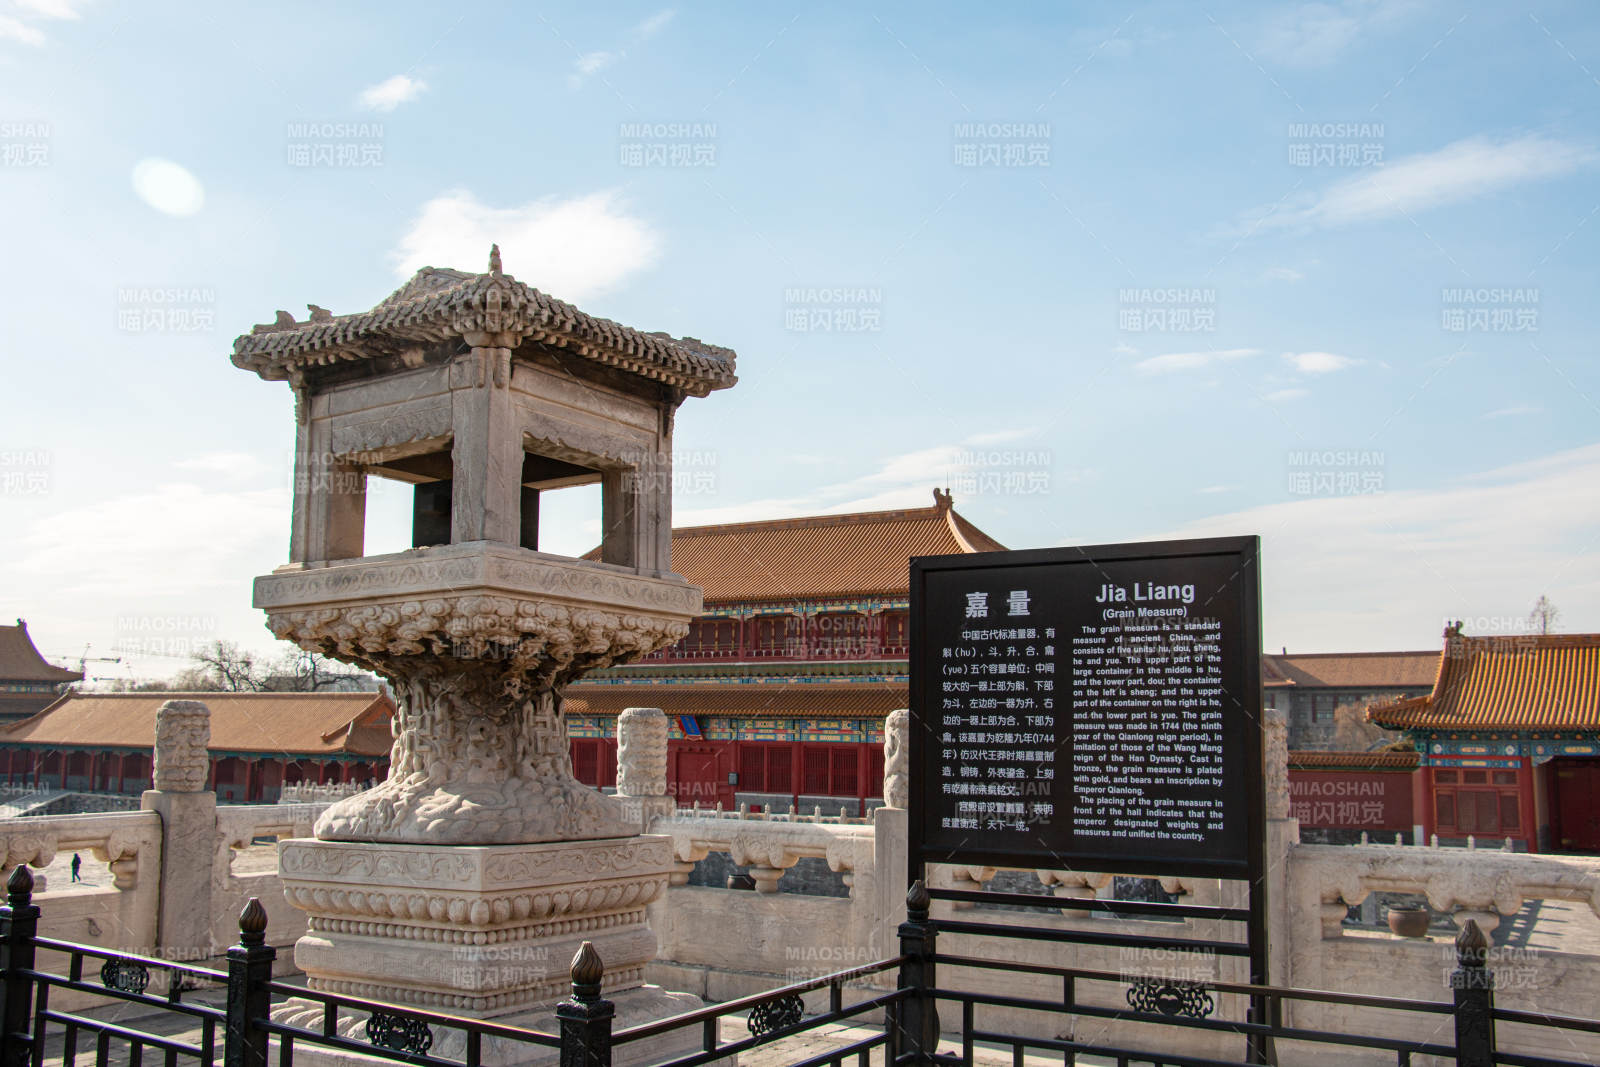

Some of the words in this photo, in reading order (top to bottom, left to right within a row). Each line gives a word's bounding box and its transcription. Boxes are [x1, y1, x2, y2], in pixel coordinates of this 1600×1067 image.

[1095, 583, 1126, 603] Jia
[1134, 581, 1195, 604] Liang
[1102, 606, 1134, 620] (Grain
[1137, 606, 1187, 619] Measure)
[1081, 625, 1096, 634] The
[1100, 624, 1120, 634] grain
[1162, 623, 1170, 631] is
[1184, 621, 1220, 630] standard
[1114, 634, 1123, 643] of
[1130, 634, 1161, 642] ancient
[1168, 633, 1196, 643] China,
[1204, 632, 1220, 641] and
[1072, 646, 1104, 655] consists
[1106, 646, 1115, 654] of
[1116, 645, 1131, 654] five
[1158, 644, 1170, 654] hu,
[1172, 644, 1191, 654] dou,
[1193, 643, 1221, 653] sheng,
[1072, 657, 1082, 665] he
[1086, 656, 1101, 665] and
[1104, 657, 1121, 666] yue.
[1126, 656, 1141, 664] The
[1144, 657, 1169, 665] upper
[1172, 655, 1190, 664] part
[1194, 655, 1203, 663] of
[1206, 654, 1221, 663] the
[1072, 667, 1092, 676] large
[1095, 666, 1132, 675] container
[1136, 666, 1144, 674] in
[1147, 666, 1161, 674] the
[1164, 665, 1192, 674] middle
[1196, 665, 1203, 673] is
[1207, 665, 1221, 674] hu,
[1072, 678, 1087, 686] and
[1088, 678, 1101, 686] the
[1103, 677, 1125, 686] lower
[1126, 677, 1145, 686] part,
[1167, 676, 1181, 685] the
[1182, 676, 1221, 684] container
[1086, 688, 1099, 696] the
[1102, 688, 1115, 696] left
[1118, 688, 1126, 696] is
[1160, 687, 1176, 695] and
[1180, 687, 1193, 695] the
[1197, 688, 1221, 696] upper
[1072, 698, 1088, 708] part
[1089, 698, 1098, 706] of
[1099, 698, 1111, 706] the
[1113, 698, 1150, 706] container
[1163, 698, 1176, 706] the
[1178, 698, 1197, 707] right
[1199, 698, 1207, 706] is
[1208, 698, 1221, 707] he,
[1073, 711, 1087, 719] and
[1090, 711, 1103, 719] the
[1106, 711, 1128, 719] lower
[1130, 711, 1147, 721] part
[1150, 711, 1158, 719] is
[1161, 713, 1178, 721] yue.
[1181, 711, 1197, 719] The
[1200, 711, 1222, 721] grain
[1125, 722, 1147, 730] made
[1149, 722, 1158, 730] in
[1160, 722, 1179, 730] 1744
[1182, 722, 1198, 731] (the
[1200, 722, 1222, 730] ninth
[1073, 734, 1090, 742] year
[1092, 732, 1101, 740] of
[1102, 732, 1115, 740] the
[1118, 732, 1153, 742] Qianlong
[1156, 732, 1177, 742] reign
[1179, 733, 1211, 742] period),
[1213, 733, 1222, 741] in
[1073, 742, 1106, 751] imitation
[1109, 743, 1118, 751] of
[1120, 743, 1143, 751] those
[1145, 743, 1154, 751] of
[1157, 743, 1170, 752] the
[1173, 743, 1196, 753] Wang
[1199, 744, 1222, 753] Mang
[1073, 753, 1093, 763] reign
[1097, 753, 1107, 762] of
[1110, 754, 1124, 762] the
[1128, 754, 1145, 762] Han
[1149, 754, 1184, 764] Dynasty.
[1189, 754, 1209, 763] Cast
[1214, 755, 1222, 763] in
[1073, 764, 1102, 774] bronze,
[1105, 764, 1118, 772] the
[1121, 764, 1143, 774] grain
[1184, 765, 1192, 774] is
[1196, 765, 1223, 775] plated
[1073, 775, 1089, 783] with
[1091, 775, 1111, 785] gold,
[1113, 775, 1128, 784] and
[1129, 776, 1152, 784] bears
[1166, 776, 1210, 786] inscription
[1212, 777, 1223, 786] by
[1073, 785, 1106, 795] Emperor
[1107, 786, 1144, 796] Qianlong.
[1079, 796, 1094, 804] The
[1096, 796, 1125, 806] placing
[1127, 797, 1136, 805] of
[1138, 797, 1151, 805] the
[1153, 797, 1174, 807] grain
[1214, 799, 1223, 807] in
[1073, 806, 1092, 815] front
[1096, 807, 1105, 815] of
[1109, 807, 1122, 816] the
[1126, 808, 1141, 816] hall
[1146, 808, 1183, 817] indicates
[1187, 809, 1205, 818] that
[1209, 810, 1223, 818] the
[1073, 819, 1106, 828] emperor
[1113, 818, 1159, 829] designated
[1166, 820, 1199, 830] weights
[1207, 821, 1223, 830] and
[1111, 828, 1127, 837] and
[1128, 829, 1155, 838] unified
[1156, 830, 1170, 838] the
[1171, 830, 1204, 841] country.
